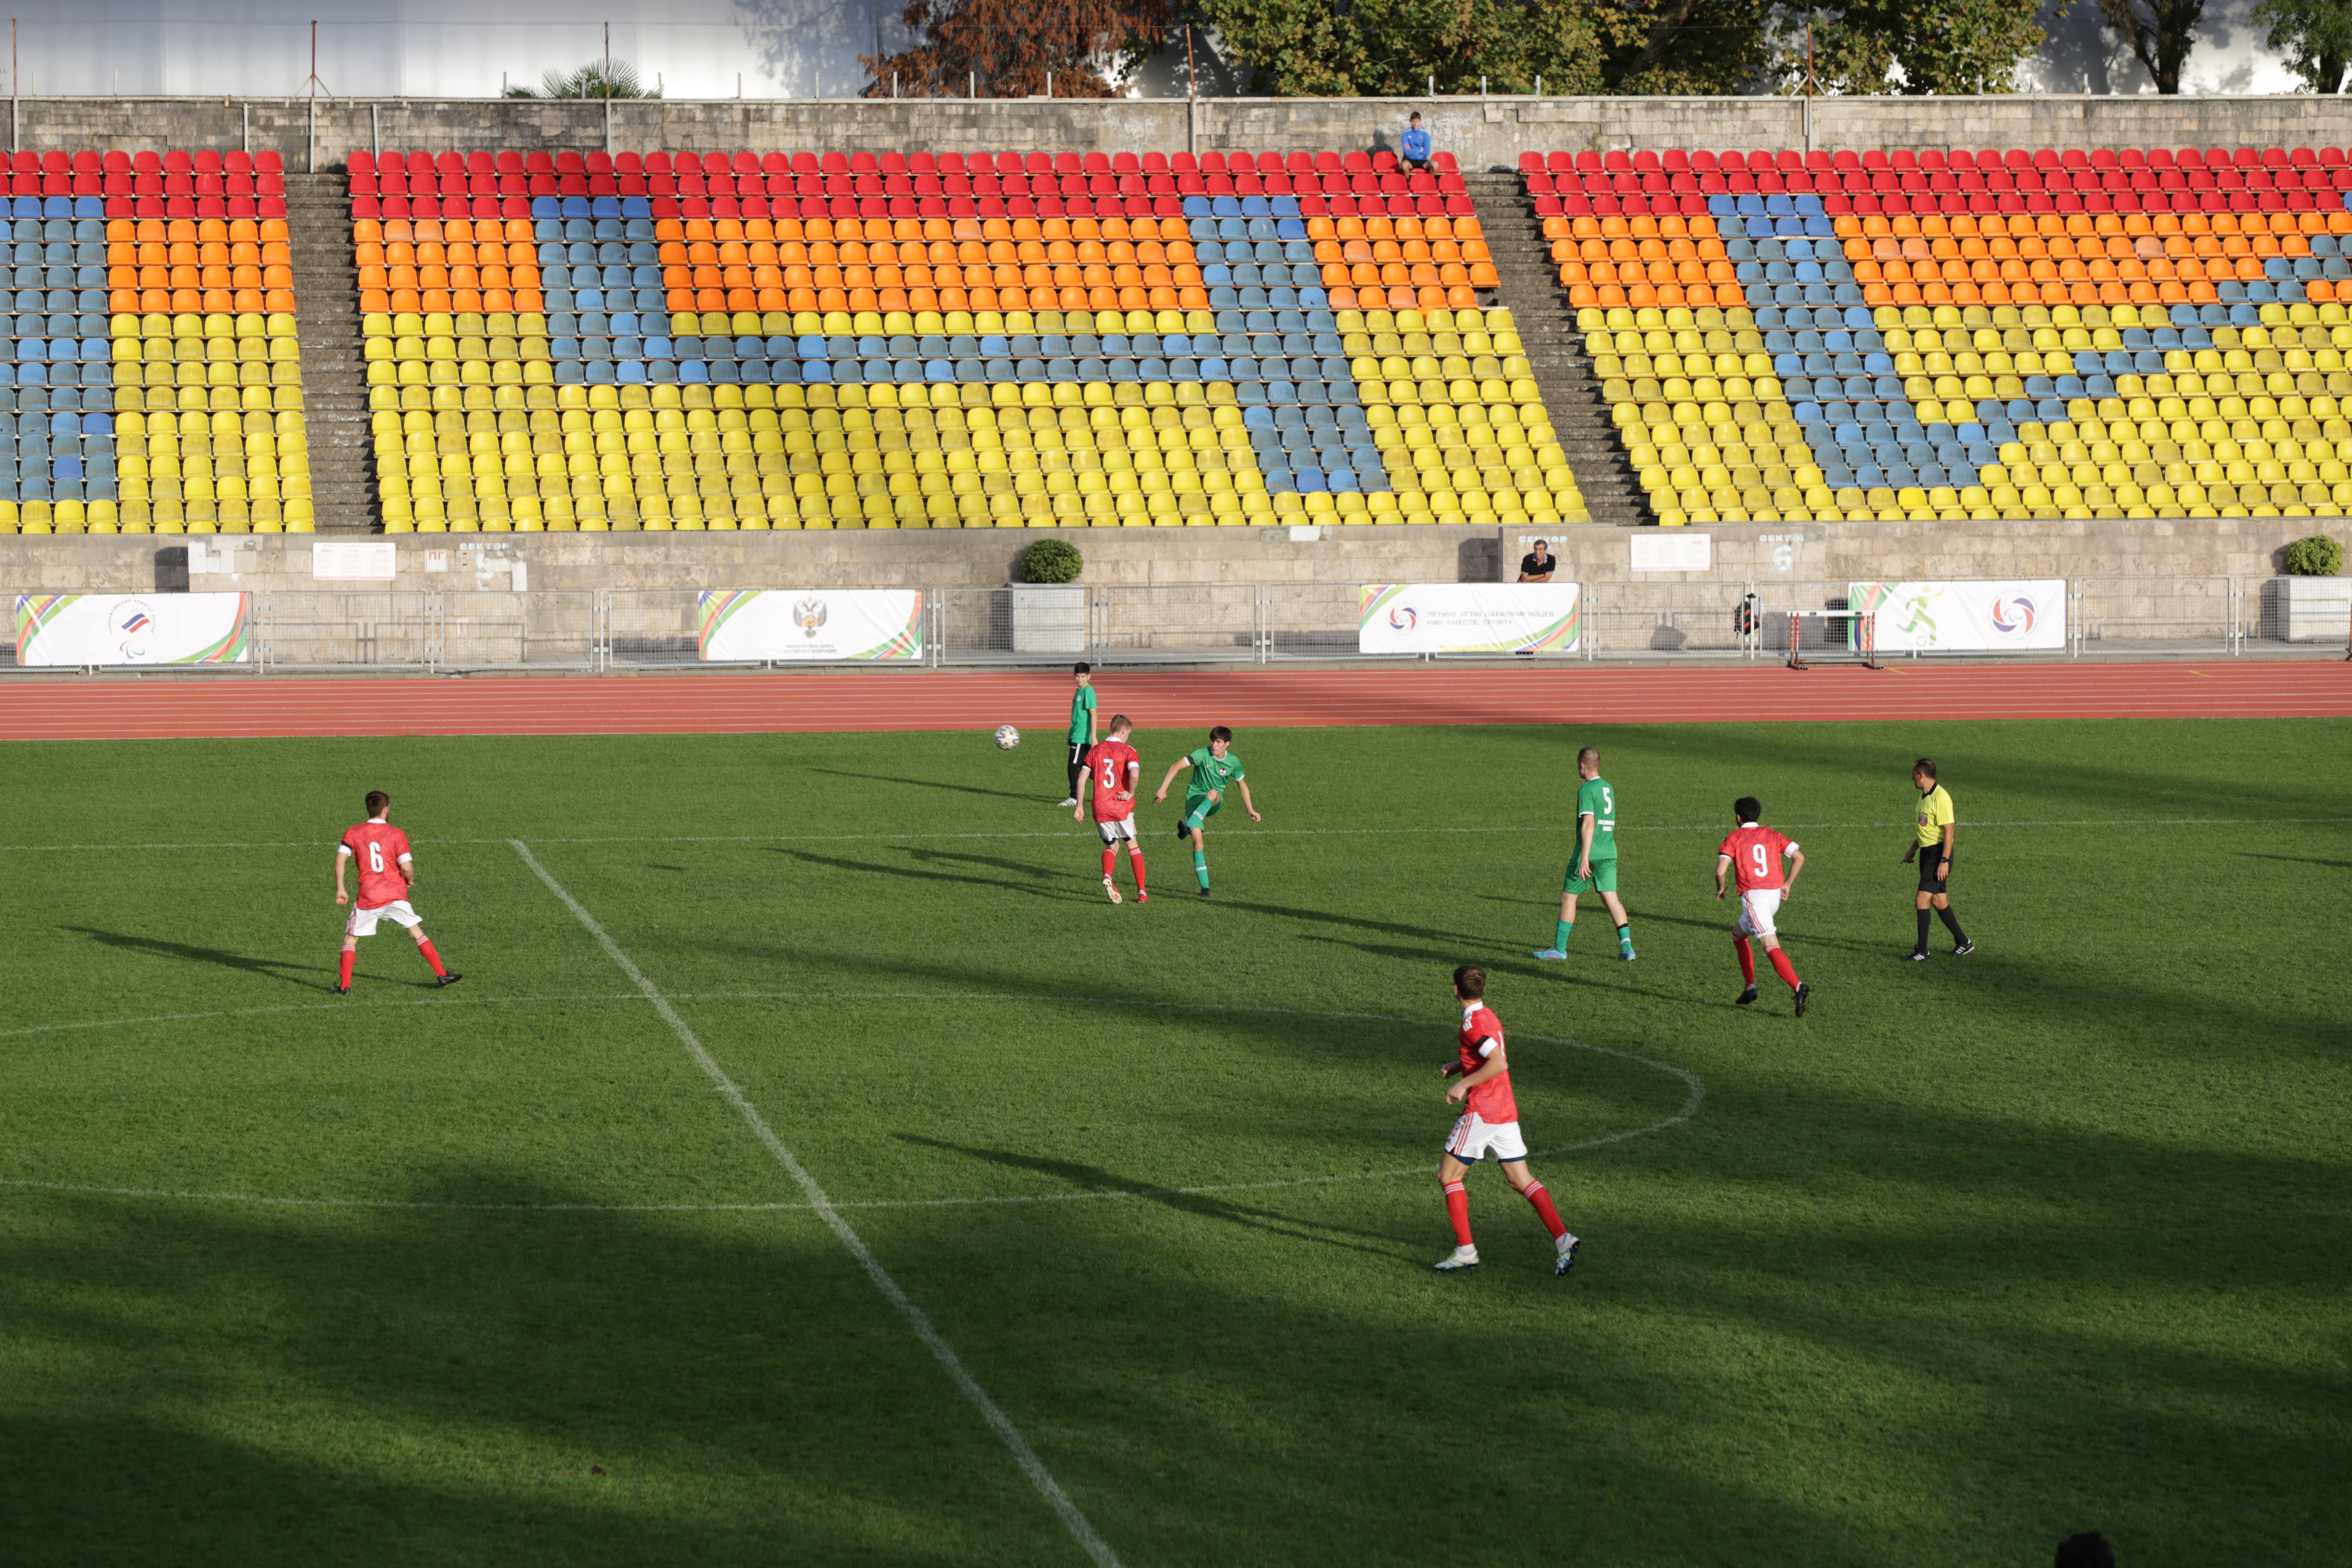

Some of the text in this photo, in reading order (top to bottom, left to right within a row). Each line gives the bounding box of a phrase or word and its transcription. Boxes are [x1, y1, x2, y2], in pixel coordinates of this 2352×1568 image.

[1774, 544, 1792, 570] 6
[134, 599, 153, 613] КОМИТЕТ
[1102, 758, 1115, 789] 3
[1602, 787, 1612, 815] 5
[369, 841, 384, 873] 6
[1752, 844, 1768, 878] 9
